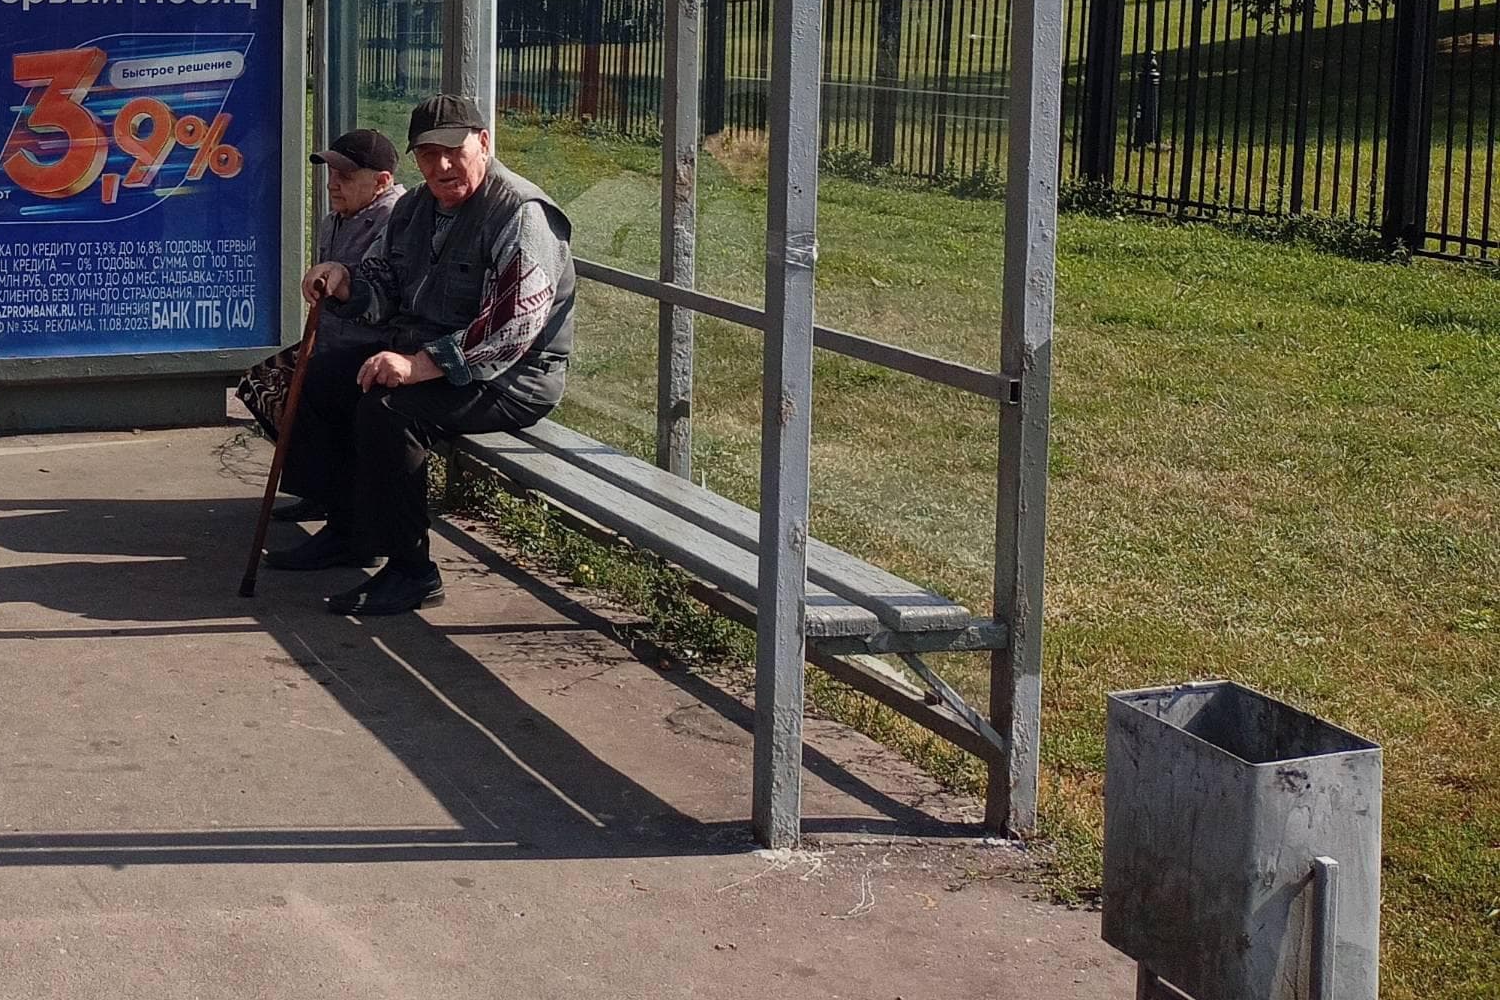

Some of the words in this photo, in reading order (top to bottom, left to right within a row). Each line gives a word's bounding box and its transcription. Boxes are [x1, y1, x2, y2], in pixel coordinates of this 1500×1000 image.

[121, 64, 175, 80] Быстрое
[177, 59, 233, 76] решение
[3, 46, 244, 204] 3,9%
[14, 243, 29, 256] ПО
[32, 242, 76, 257] КРЕДИТУ
[78, 242, 92, 255] ОТ
[94, 242, 116, 256] 3,9%
[118, 242, 133, 255] ДО
[137, 241, 162, 256] 16,8%
[165, 240, 214, 255] ГОДОВЫХ,
[217, 236, 256, 252] ПЕРВЫЙ
[13, 259, 56, 273] КРЕДИТА
[77, 258, 92, 271] 0%
[97, 257, 147, 271] ГОДОВЫХ.
[152, 256, 188, 269] СУММА
[192, 256, 206, 268] ОТ
[211, 255, 227, 268] 100
[233, 254, 256, 268] ТЫС.
[22, 274, 46, 288] РУБ.,
[48, 273, 75, 286] СРОК
[78, 273, 92, 286] ОТ
[93, 273, 103, 286] 13
[105, 272, 120, 286] ДО
[121, 272, 133, 285] 60
[136, 271, 159, 284] МЕС.
[161, 271, 215, 285] НАДБАВКА:
[236, 270, 256, 283] П.П.
[52, 289, 69, 302] БЕЗ
[71, 287, 120, 301] ЛИЧНОГО
[122, 286, 195, 300] СТРАХОВАНИЯ.
[198, 284, 256, 299] ПОДРОБНЕЕ
[78, 303, 98, 317] ГЕН.
[100, 302, 150, 317] ЛИЦЕНЗИЯ
[151, 301, 191, 330] БАНК
[195, 300, 222, 329] ГПБ
[226, 297, 255, 331] (АО)
[7, 321, 20, 333] №
[21, 320, 42, 334] 354.
[45, 318, 96, 332] РЕКЛАМА.
